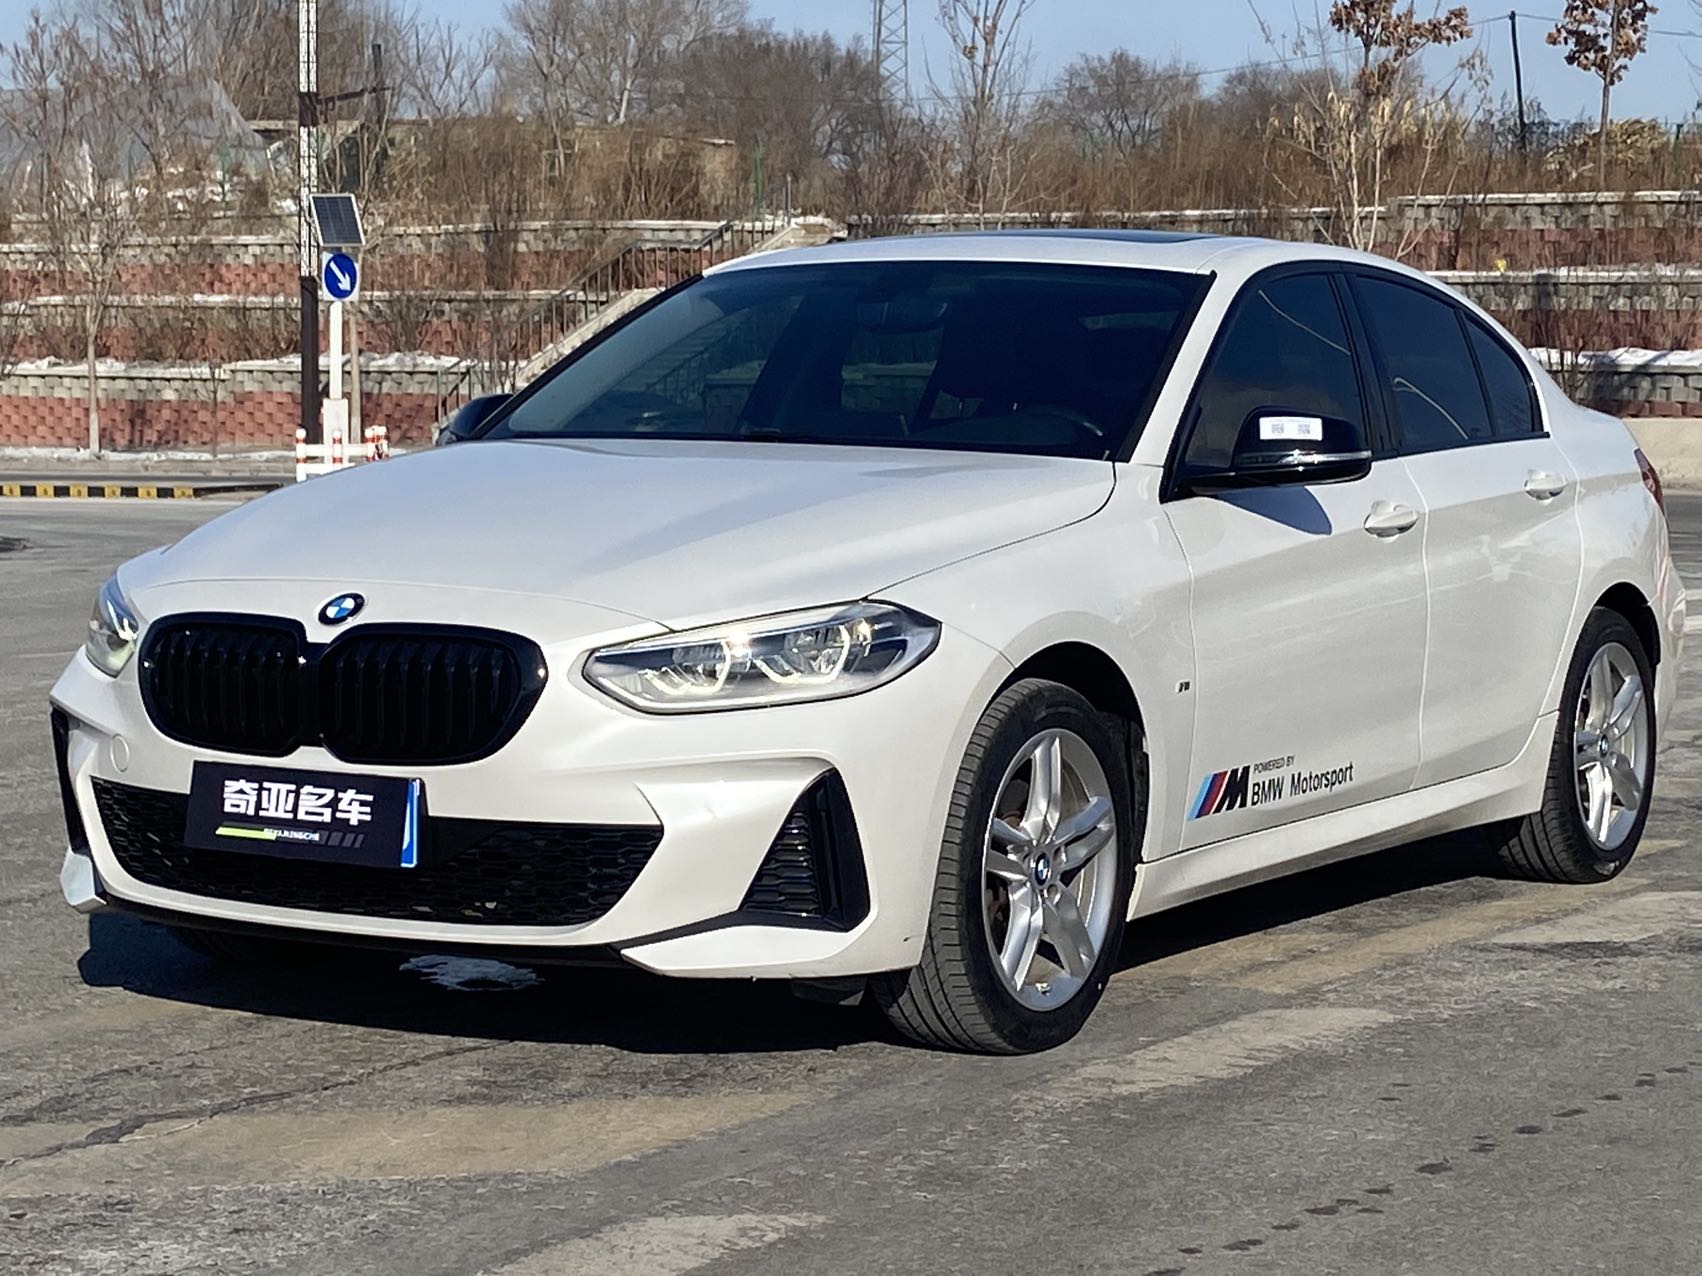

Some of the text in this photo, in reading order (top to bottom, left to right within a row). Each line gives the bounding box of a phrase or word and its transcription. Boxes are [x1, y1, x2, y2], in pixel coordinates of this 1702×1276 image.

[1251, 762, 1354, 807] BMW Motorsport
[1253, 755, 1296, 774] POWERED BY
[223, 779, 374, 826] 奇亚名车
